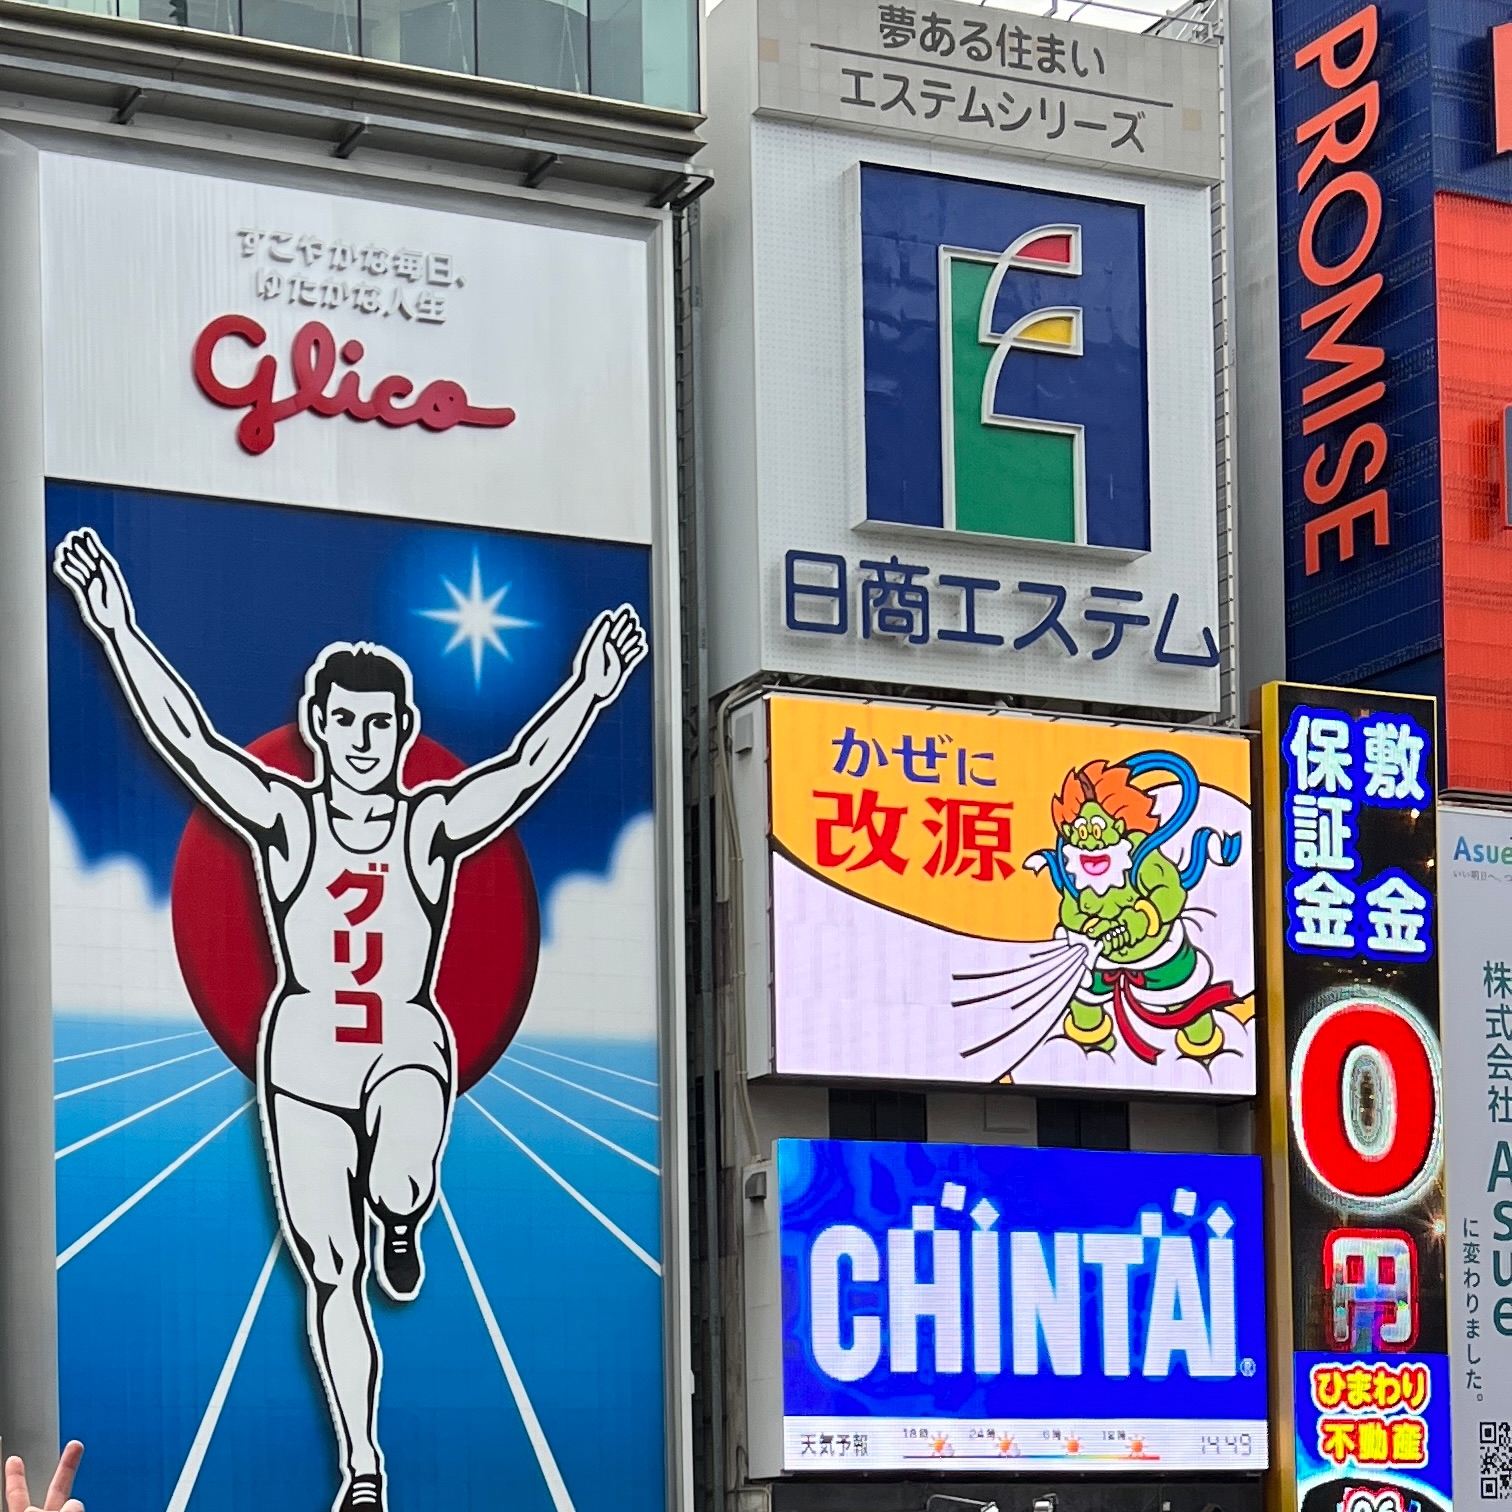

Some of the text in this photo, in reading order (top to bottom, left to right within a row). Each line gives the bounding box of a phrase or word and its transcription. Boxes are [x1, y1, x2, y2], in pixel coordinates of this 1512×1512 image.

[878, 4, 1105, 77] 夢ある住まい
[840, 68, 1146, 152] エステムシリーズ
[255, 268, 446, 324] ゆたかな人生
[1294, 5, 1390, 575] PROMISE
[193, 314, 516, 456] Glico
[785, 549, 1219, 667] 日商エステム
[832, 727, 997, 786] かぜに
[812, 789, 1017, 881] 改源
[1291, 714, 1355, 950] 保証金
[326, 862, 389, 1044] グリコ
[1293, 1000, 1440, 1202] 0
[1326, 1229, 1417, 1350] 円
[1462, 1217, 1484, 1402] に変わりました。
[1314, 1365, 1428, 1412] ひまわり
[800, 1432, 869, 1457] 天気予報
[1322, 1421, 1425, 1463] 不動産
